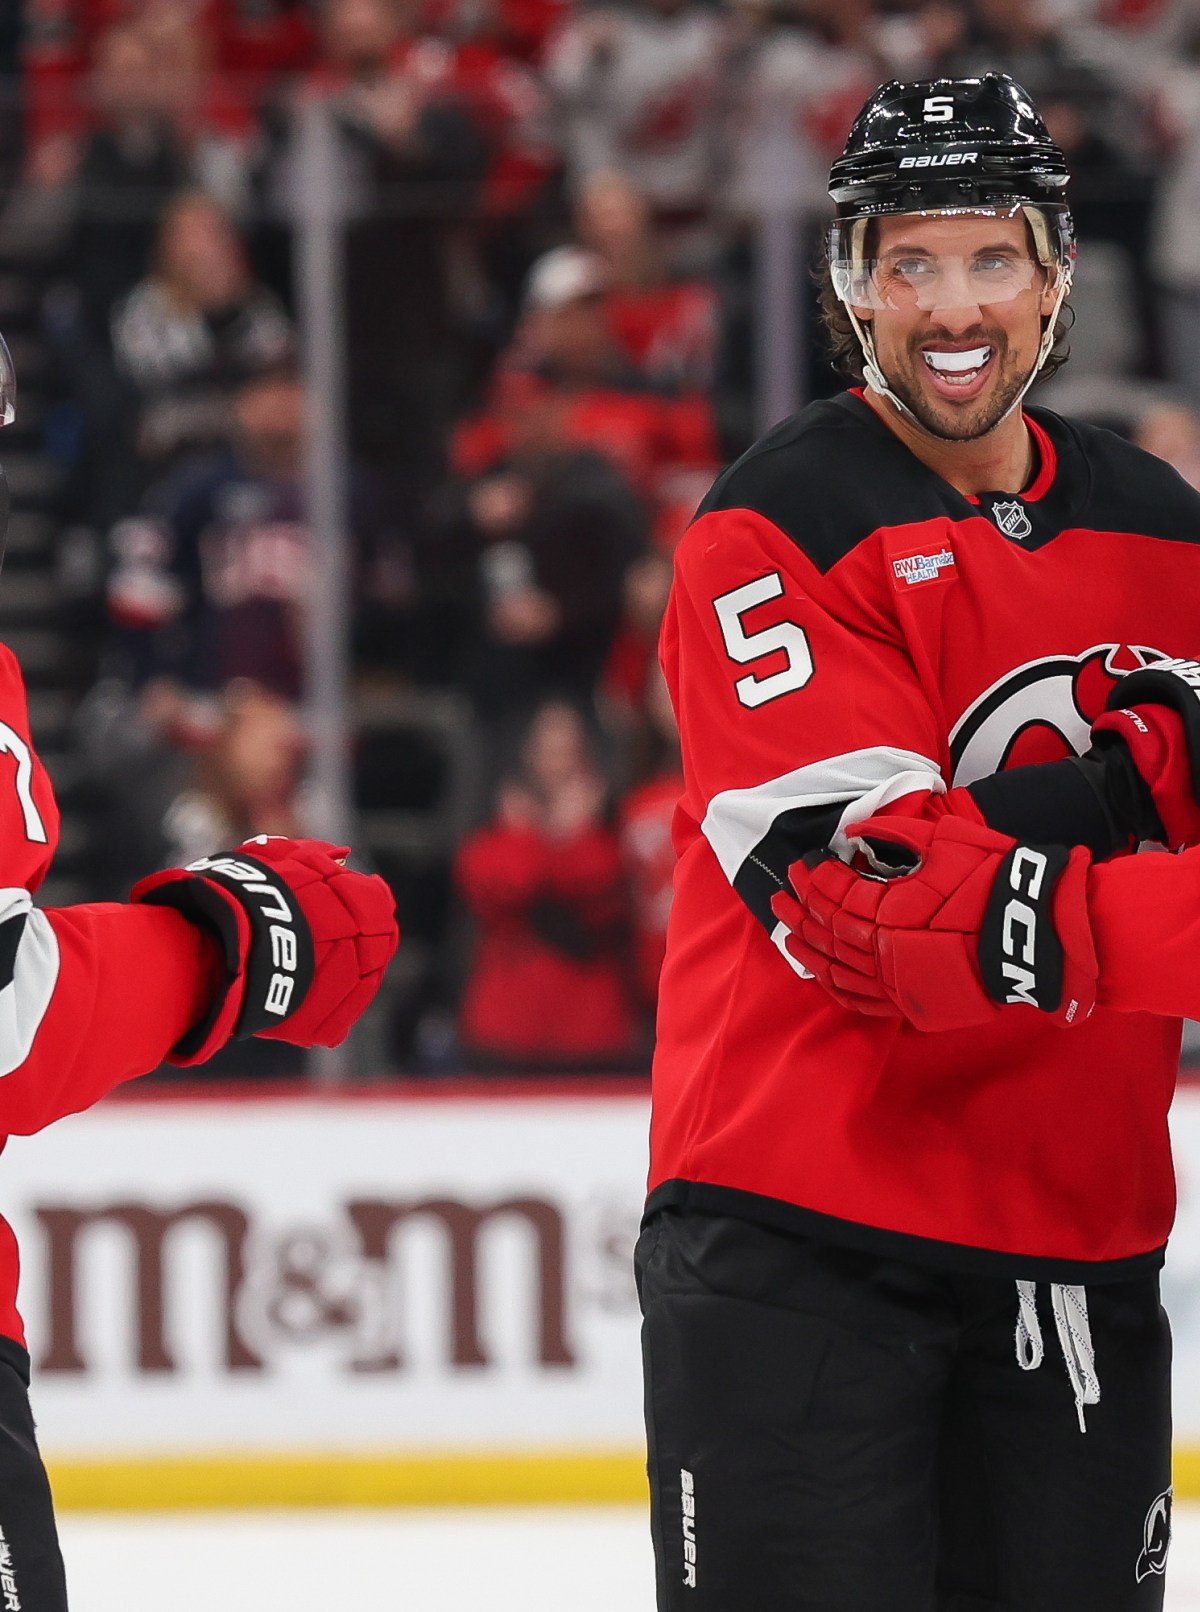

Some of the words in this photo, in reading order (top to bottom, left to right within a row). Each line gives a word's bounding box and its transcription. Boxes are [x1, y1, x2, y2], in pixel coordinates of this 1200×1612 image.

[899, 152, 978, 168] BAUER
[923, 96, 954, 122] 5
[906, 567, 938, 583] HEALTH
[712, 570, 816, 711] 5
[185, 857, 298, 1018] BAUER
[1001, 846, 1048, 1009] CCM
[0, 1525, 22, 1612] AUER
[680, 1467, 697, 1589] BAUER
